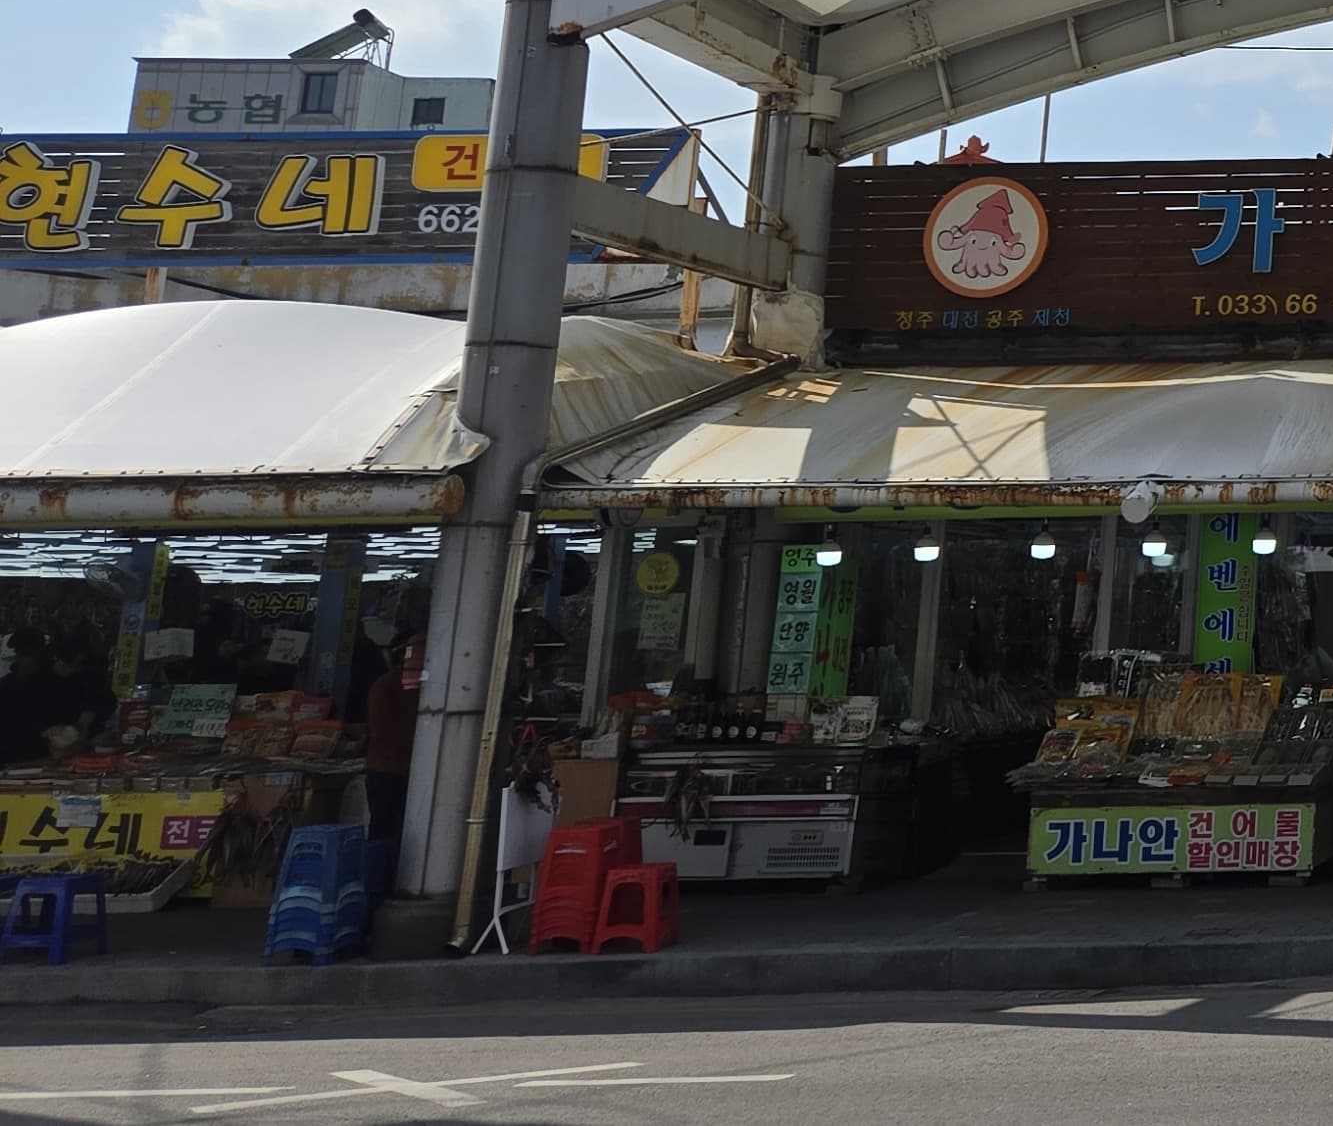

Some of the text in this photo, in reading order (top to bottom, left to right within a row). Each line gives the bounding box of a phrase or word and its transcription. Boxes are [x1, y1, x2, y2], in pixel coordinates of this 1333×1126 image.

[186, 92, 283, 127] 농협
[0, 140, 388, 252] 현수네
[986, 308, 1025, 330] 공주
[245, 592, 309, 618] 현수네
[0, 805, 143, 855] 수네
[1188, 810, 1301, 838] 건어물
[1045, 819, 1178, 865] 가나안
[1187, 841, 1301, 870] 할인매장
